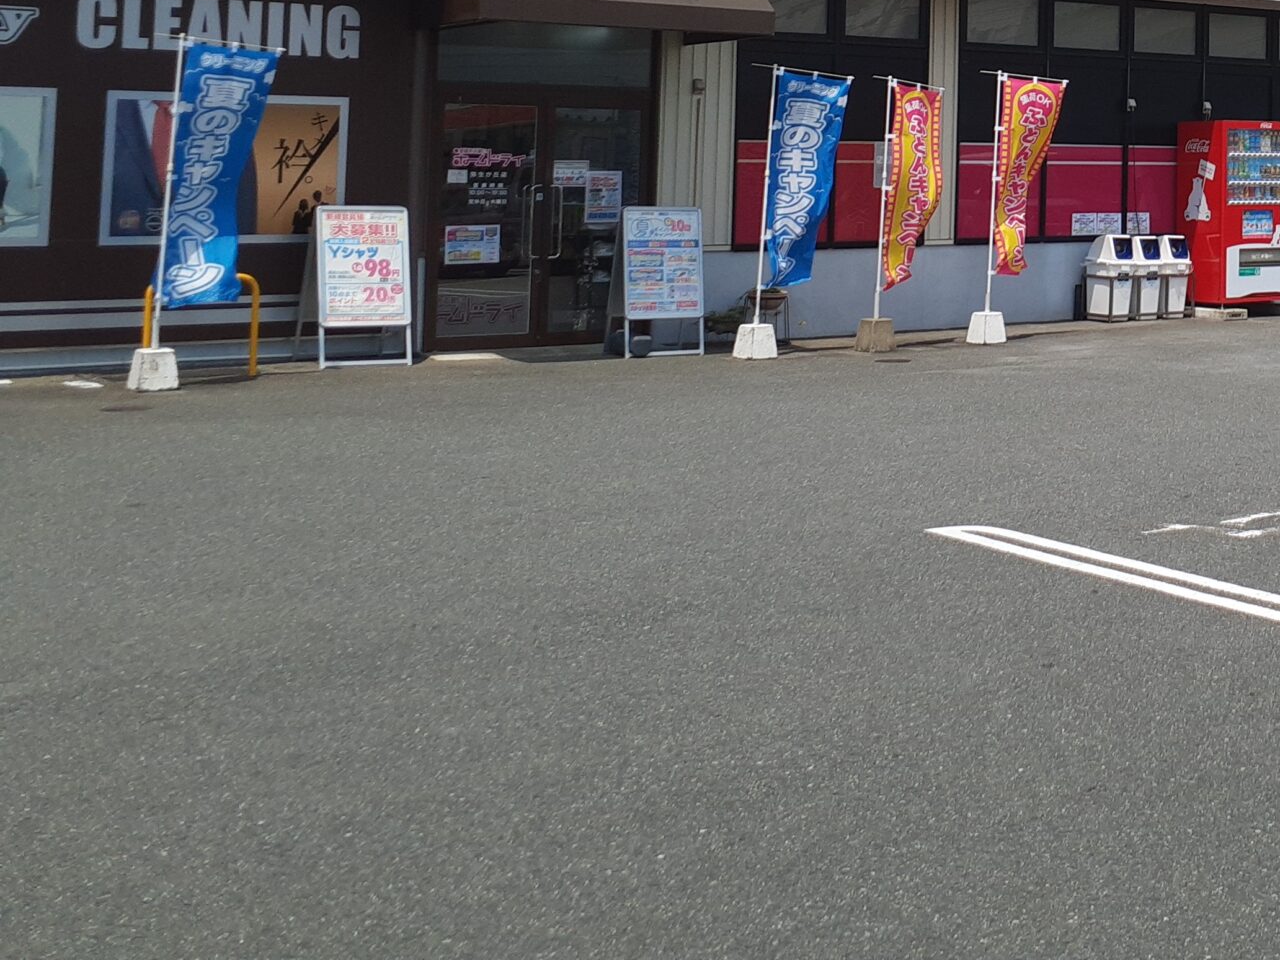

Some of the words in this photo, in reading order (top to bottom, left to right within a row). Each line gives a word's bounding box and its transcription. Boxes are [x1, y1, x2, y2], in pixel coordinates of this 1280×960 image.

[200, 52, 269, 73] クリーニング
[787, 80, 840, 97] クリーニング
[167, 74, 255, 299] 夏のキャンペーン
